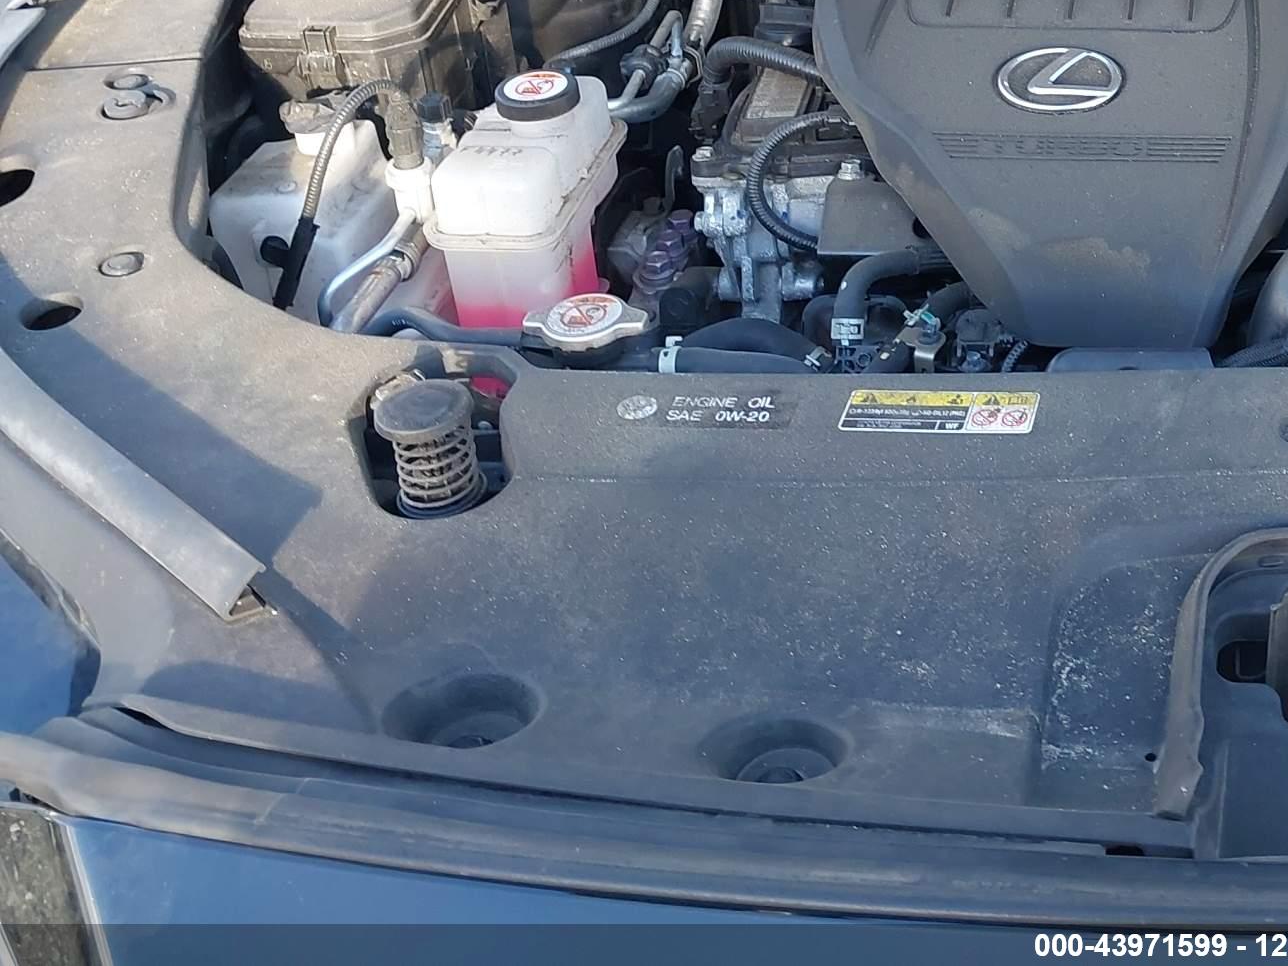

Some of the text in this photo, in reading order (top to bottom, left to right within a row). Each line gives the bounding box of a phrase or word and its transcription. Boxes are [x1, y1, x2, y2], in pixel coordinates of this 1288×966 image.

[671, 395, 776, 409] ENGINE OIL
[665, 409, 771, 423] SAE 0W-20
